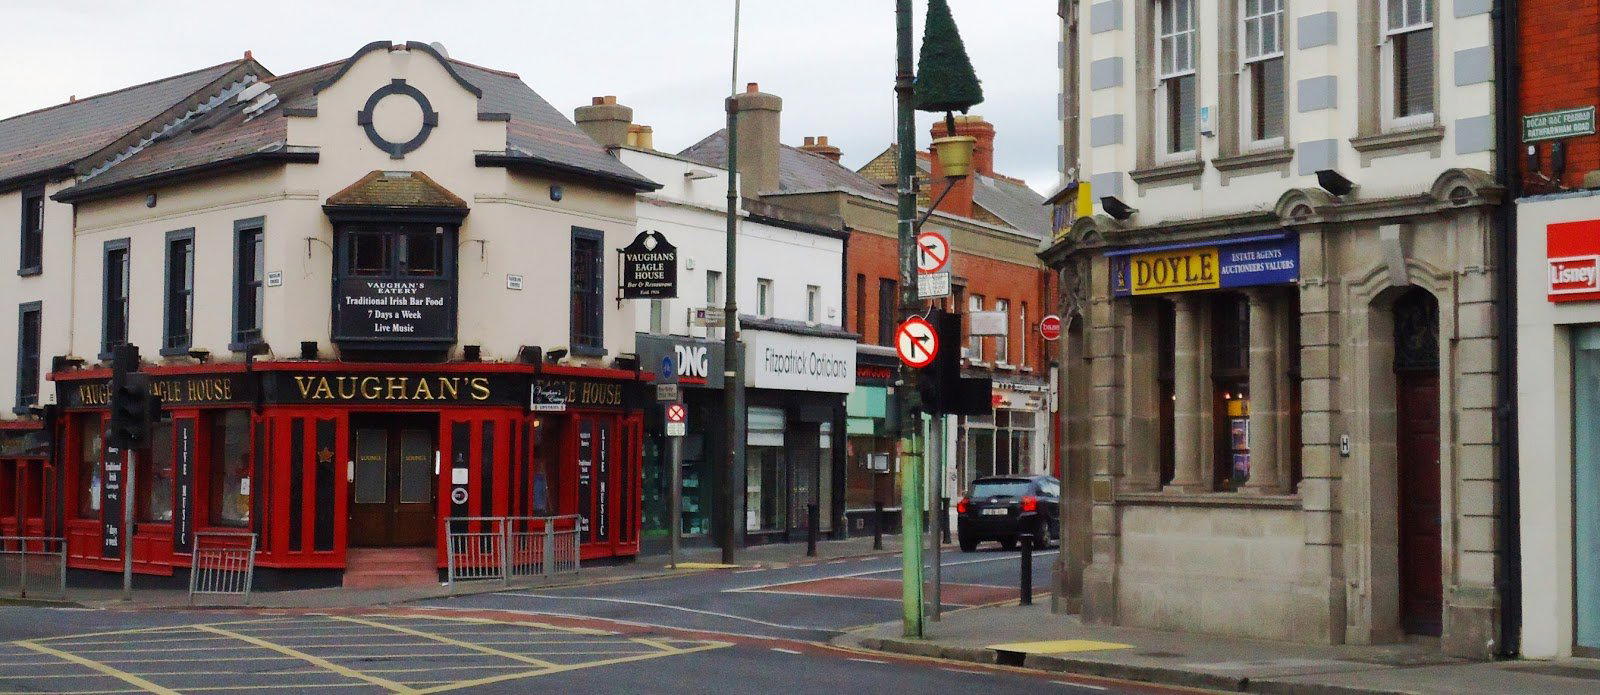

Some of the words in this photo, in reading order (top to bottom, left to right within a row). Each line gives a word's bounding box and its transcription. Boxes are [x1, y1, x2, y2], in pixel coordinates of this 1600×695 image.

[626, 253, 674, 261] VAUGHANS
[1232, 251, 1255, 262] ESTATE
[1257, 249, 1282, 259] AGENTS
[635, 263, 664, 271] EAGLE
[635, 271, 665, 279] HOUSE
[1136, 253, 1213, 287] DOYLE
[1222, 264, 1264, 275] AUCTIONEERS
[1265, 259, 1295, 270] VALUERS
[1551, 264, 1596, 286] Lisney
[345, 296, 388, 306] Traditional
[389, 296, 408, 306] Irish
[410, 297, 423, 306] Bar
[425, 297, 444, 306] Food
[367, 309, 373, 319] 7
[374, 309, 393, 320] Days
[401, 310, 422, 319] Week
[374, 323, 391, 332] Live
[392, 323, 414, 333] Music
[675, 345, 708, 378] DNG
[765, 348, 808, 378] Fitzpatrick
[809, 352, 848, 380] Opticians
[150, 381, 181, 402] AGLE
[188, 378, 232, 401] HOUSE
[294, 376, 491, 400] VAUGHAN'S
[582, 382, 622, 405] HOUSE
